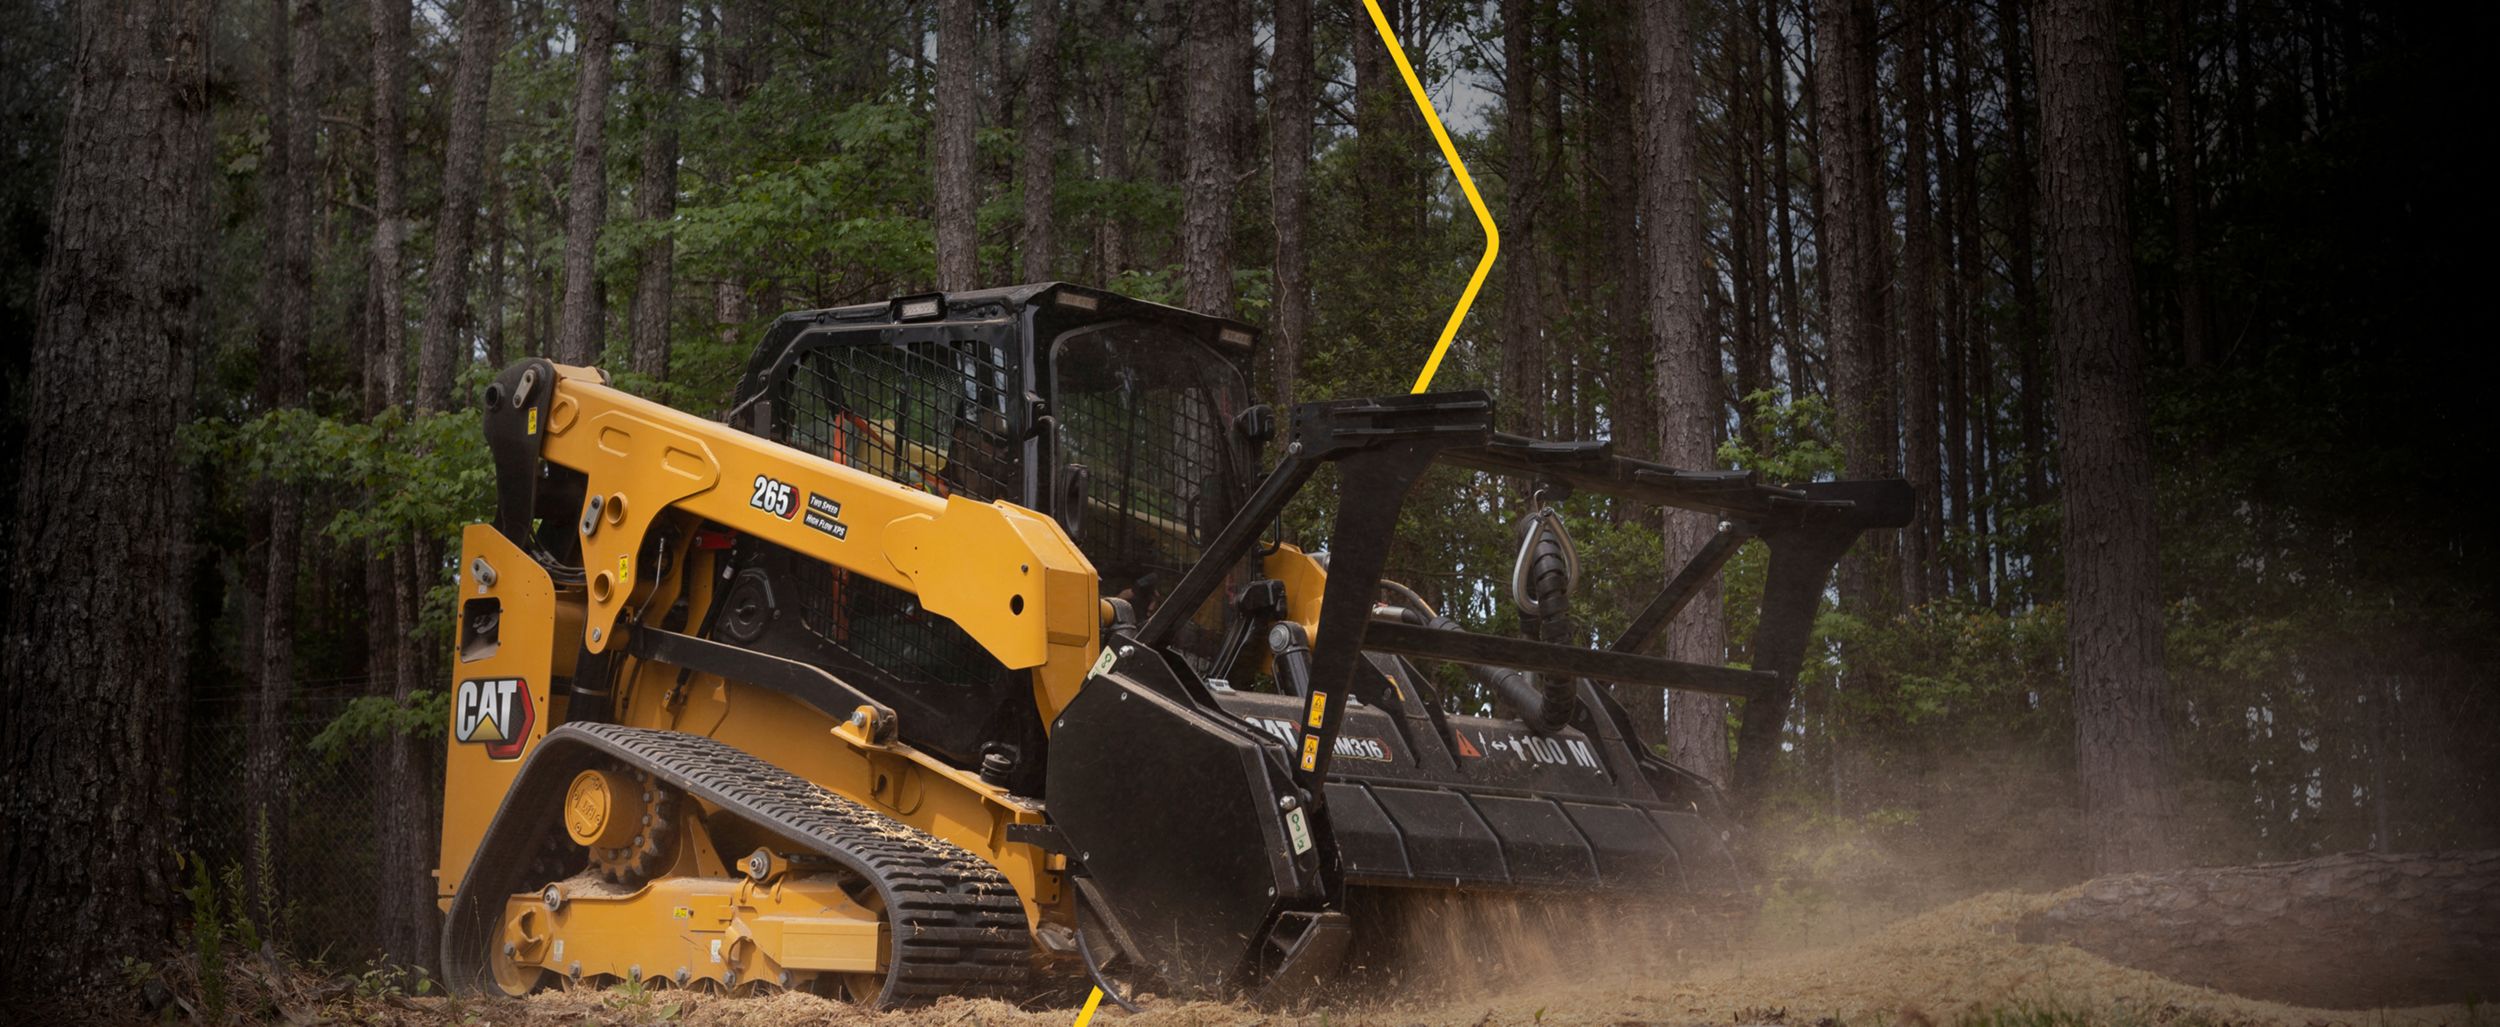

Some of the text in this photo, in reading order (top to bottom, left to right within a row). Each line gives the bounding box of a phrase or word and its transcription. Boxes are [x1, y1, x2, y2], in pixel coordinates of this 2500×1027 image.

[751, 476, 791, 516] 265
[832, 524, 846, 537] XPS
[456, 680, 518, 741] CAT
[1245, 716, 1298, 751] AT
[1522, 735, 1598, 769] 100 M
